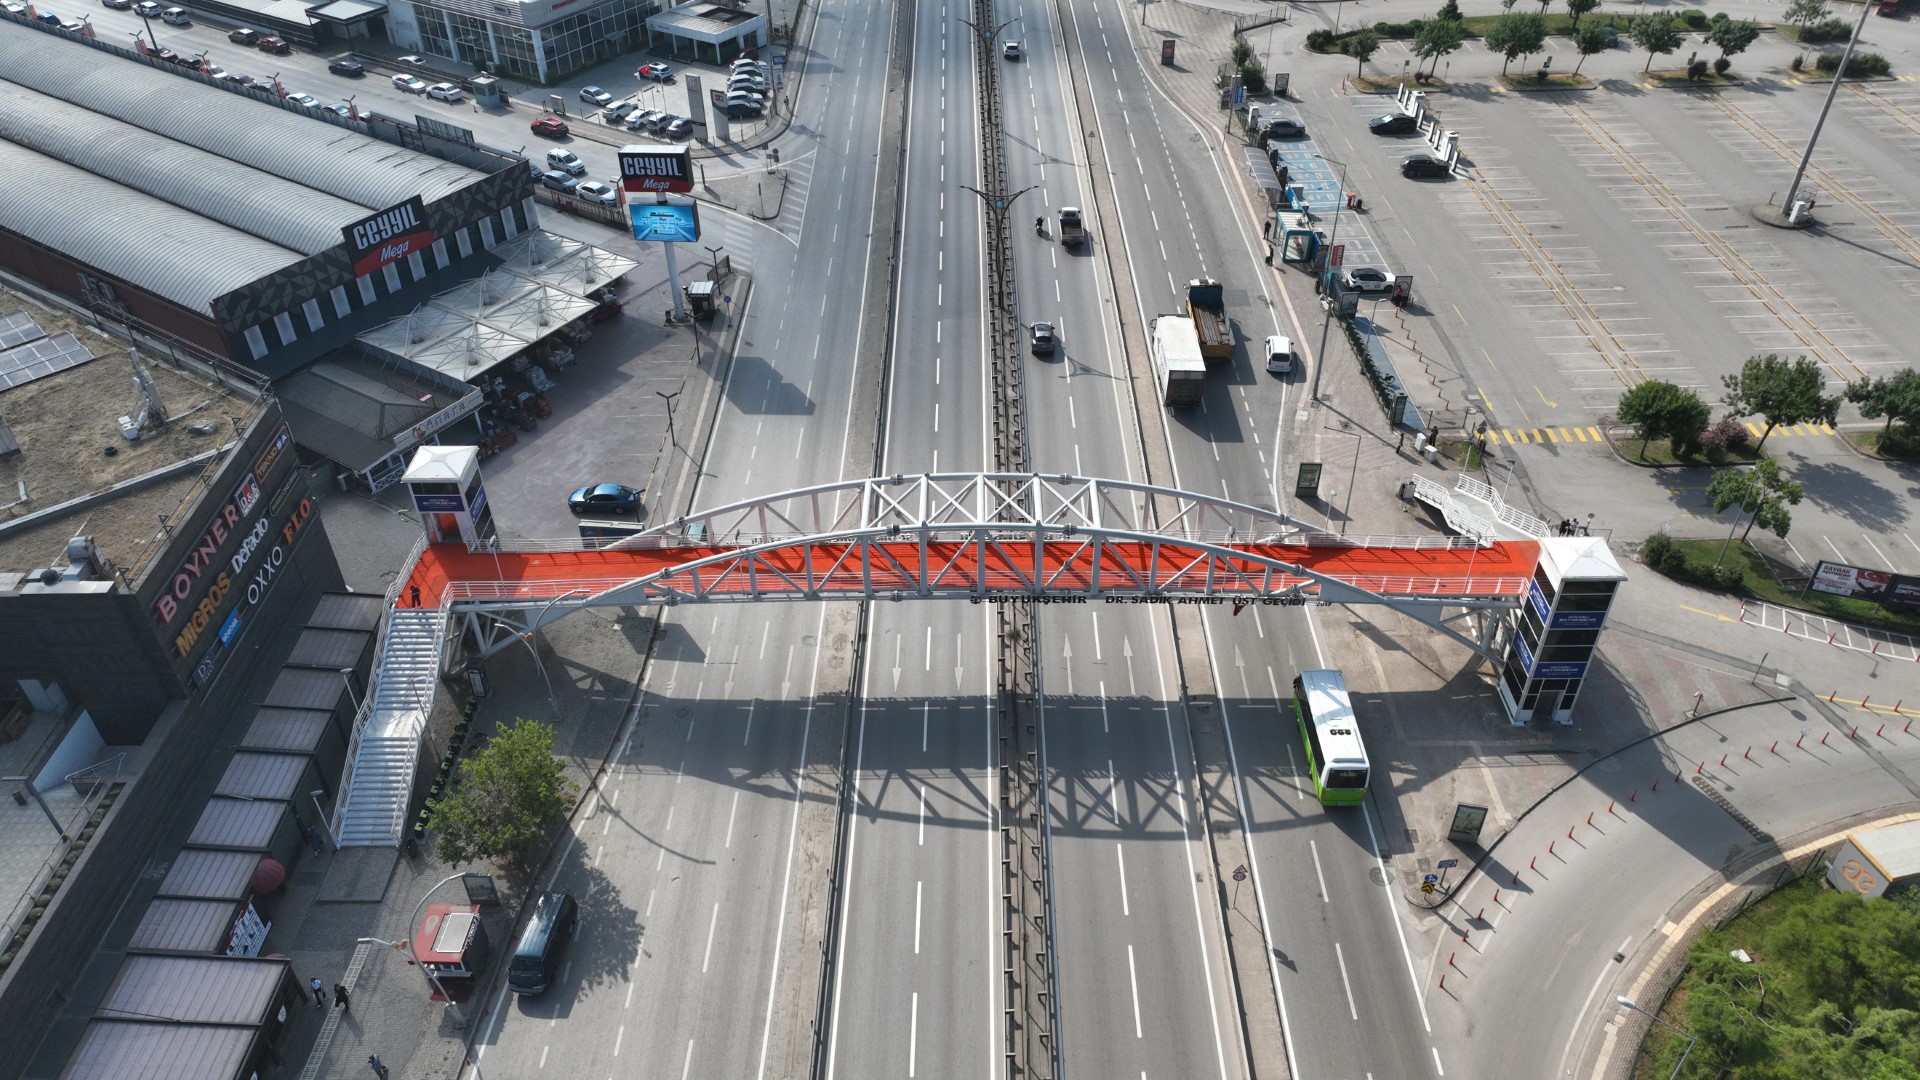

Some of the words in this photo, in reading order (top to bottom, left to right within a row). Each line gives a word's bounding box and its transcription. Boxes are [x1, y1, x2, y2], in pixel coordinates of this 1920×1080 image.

[643, 178, 671, 192] Mega
[380, 240, 410, 263] Mega
[283, 498, 311, 546] FLO
[156, 503, 240, 624] BOYNER
[247, 546, 283, 605] OXXO
[175, 571, 231, 658] MIGROS
[1105, 595, 1128, 604] DR.
[1177, 596, 1226, 605] AHMET
